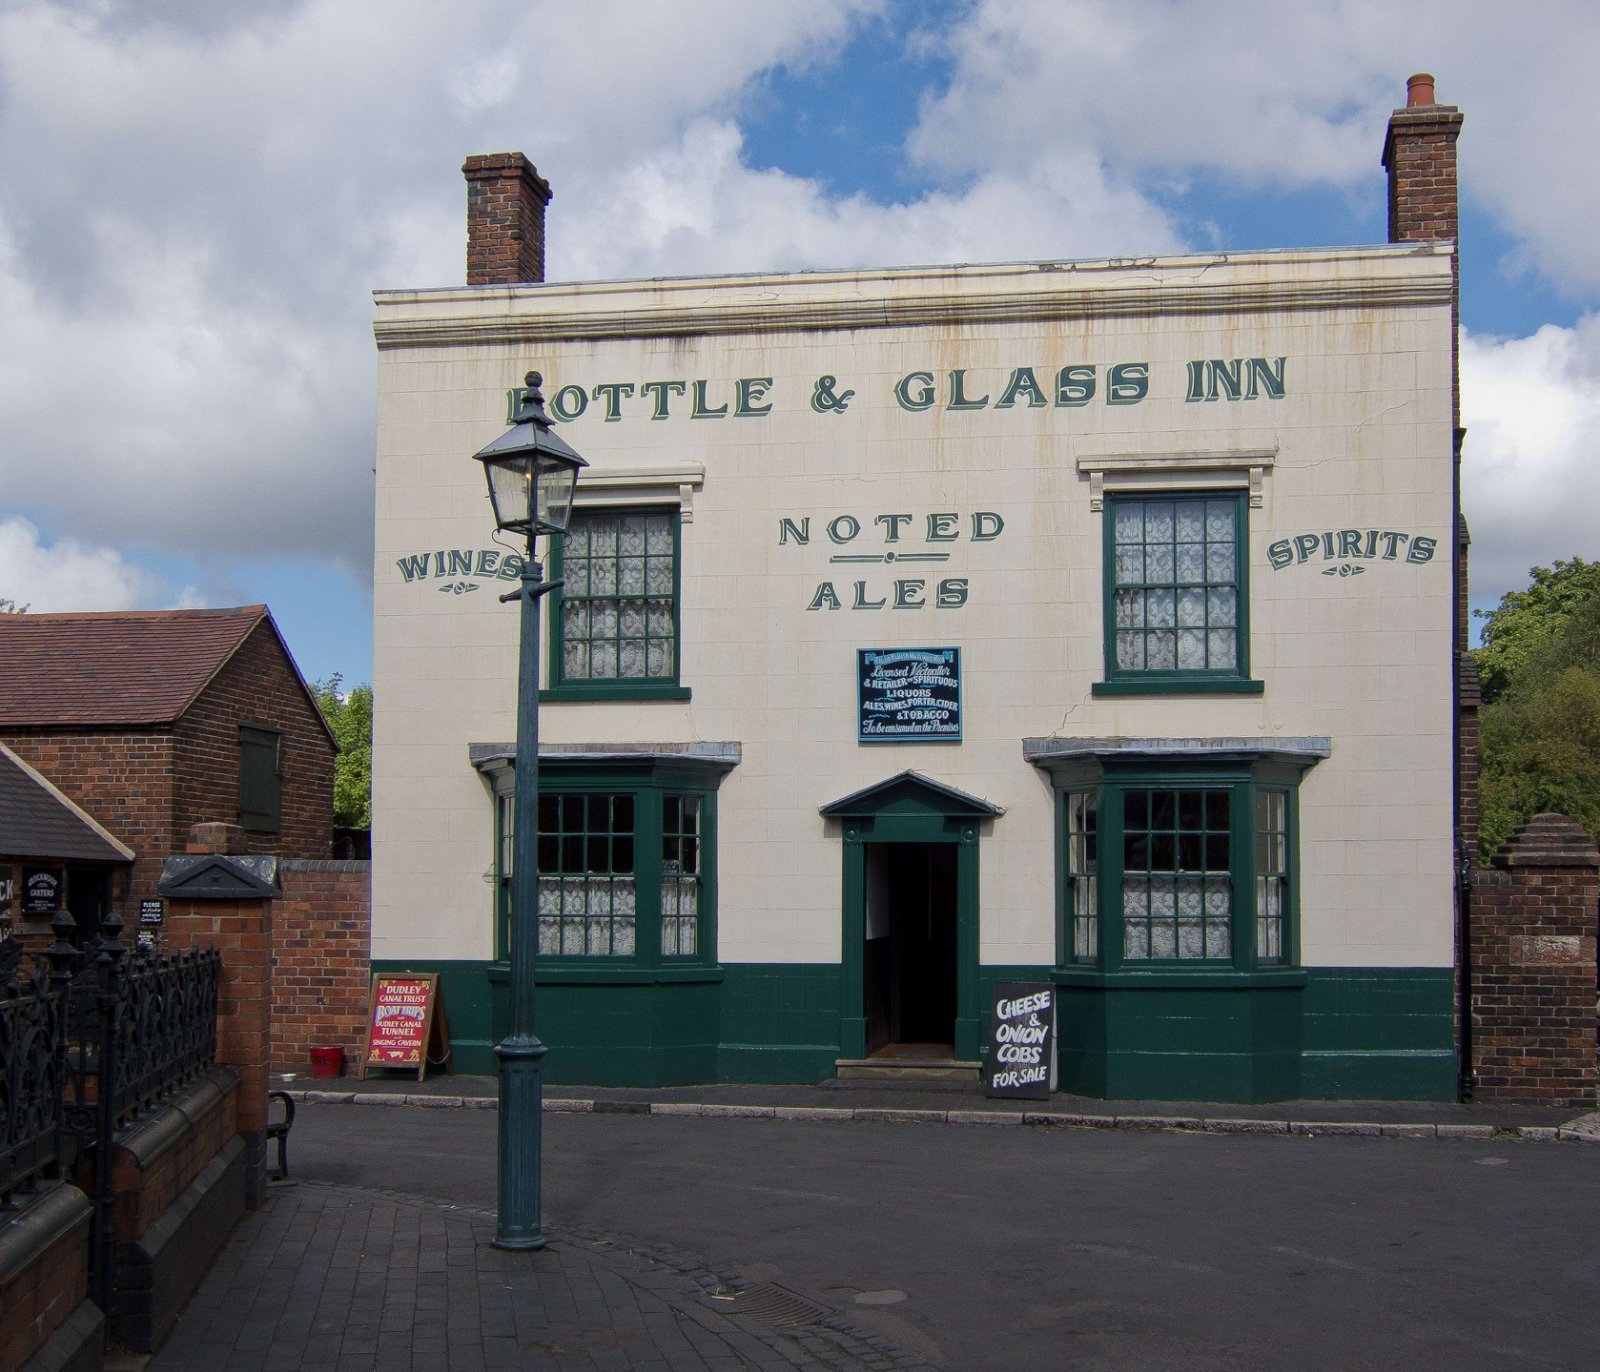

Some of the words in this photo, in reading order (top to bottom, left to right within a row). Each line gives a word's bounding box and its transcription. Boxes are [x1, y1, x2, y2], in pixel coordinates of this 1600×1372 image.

[811, 375, 855, 414] &
[893, 362, 1149, 412] GLASS
[1185, 357, 1287, 403] INN
[778, 512, 1005, 545] NOTED
[1267, 529, 1437, 571] SPIRITS
[396, 550, 524, 583] WINES
[805, 578, 969, 611] ALES
[871, 665, 908, 677] Licensed
[864, 679, 871, 688] &
[872, 678, 908, 689] RETAILER
[913, 676, 958, 688] SPIRITUOUS
[886, 689, 931, 698] LIQUORS
[902, 710, 949, 720] TOBACCO
[386, 986, 421, 994] DUDLEY
[376, 1006, 400, 1022] BOAT
[401, 1006, 426, 1020] TRIPS
[996, 990, 1051, 1020] CHEESE
[1029, 1013, 1041, 1027] &
[996, 1024, 1049, 1044] ONION
[997, 1044, 1042, 1064] COBS
[993, 1072, 1020, 1088] FOR
[1020, 1066, 1047, 1084] SALE
